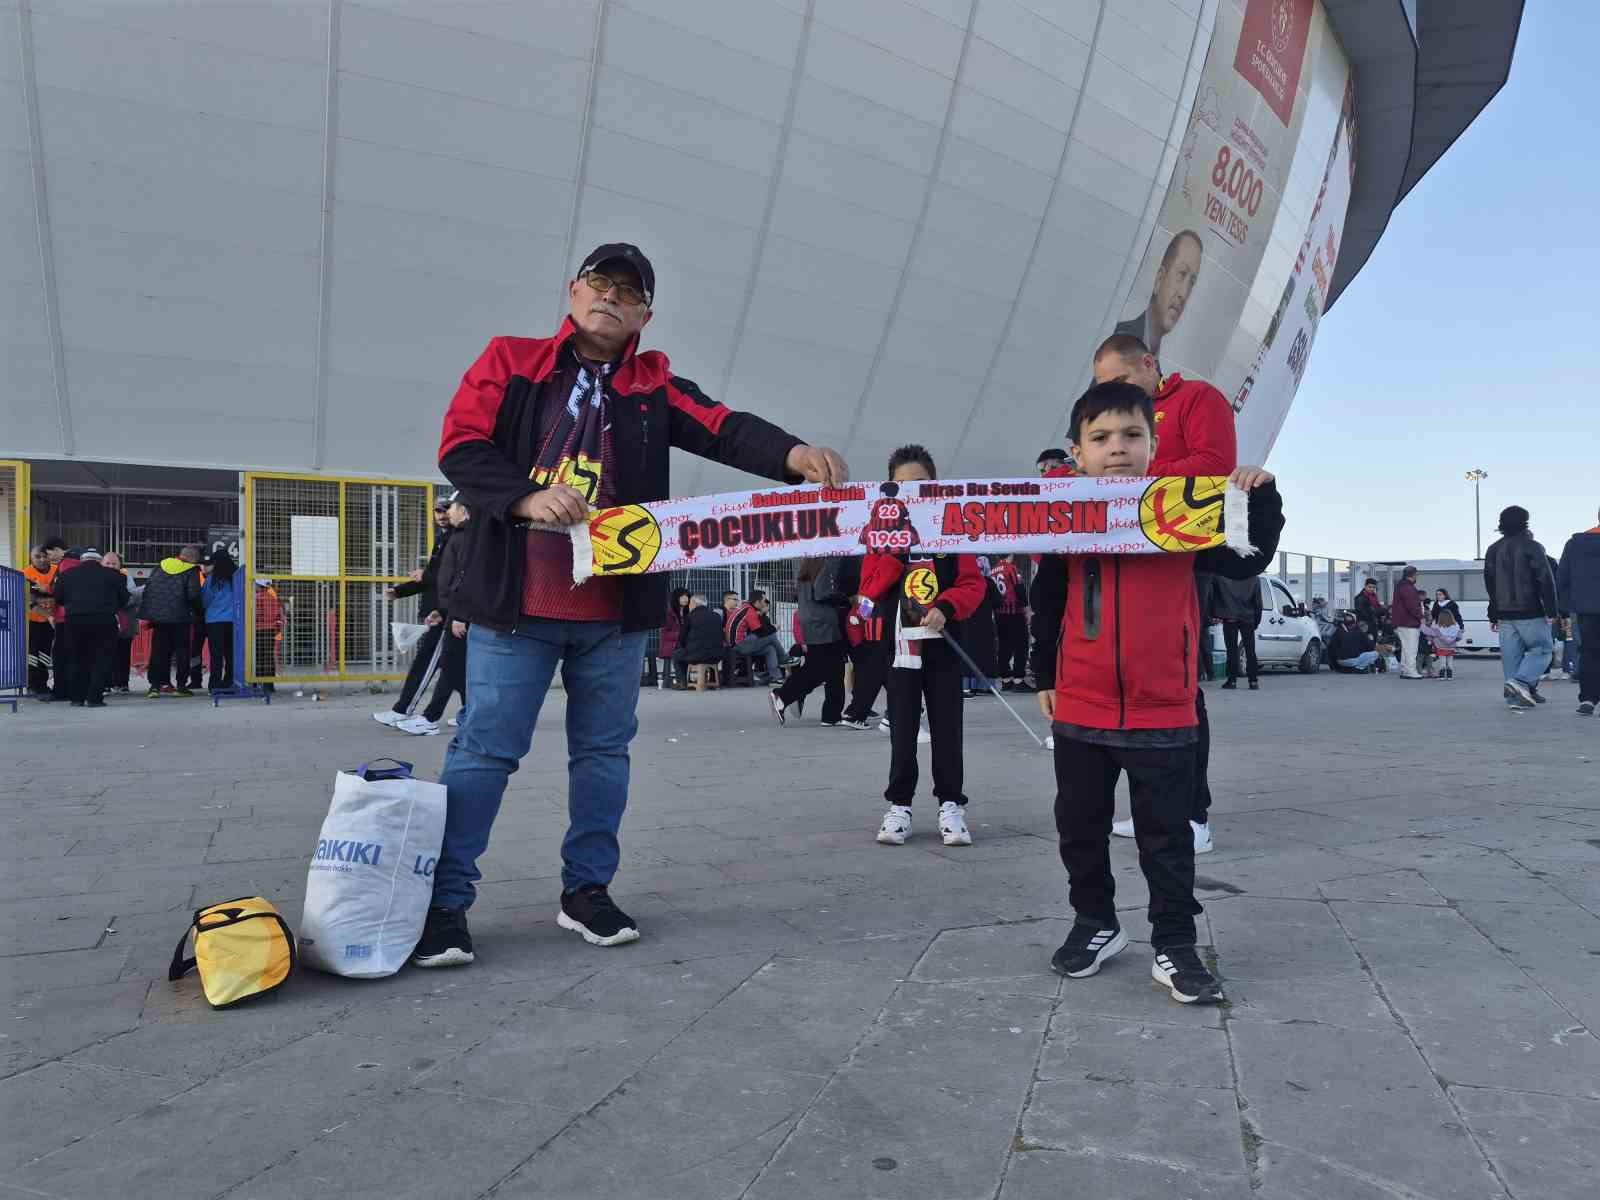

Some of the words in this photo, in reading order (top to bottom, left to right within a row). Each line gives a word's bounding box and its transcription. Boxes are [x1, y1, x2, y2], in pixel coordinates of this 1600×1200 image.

[1212, 145, 1264, 217] 8.000
[919, 483, 964, 498] Miras
[966, 482, 989, 497] Bu
[990, 482, 1041, 496] Sevda
[879, 504, 899, 519] 26
[941, 500, 1109, 541] AŞKIMSIN
[679, 507, 842, 559] ÇOCUKLUK
[868, 530, 910, 547] 1965
[414, 855, 435, 876] LC
